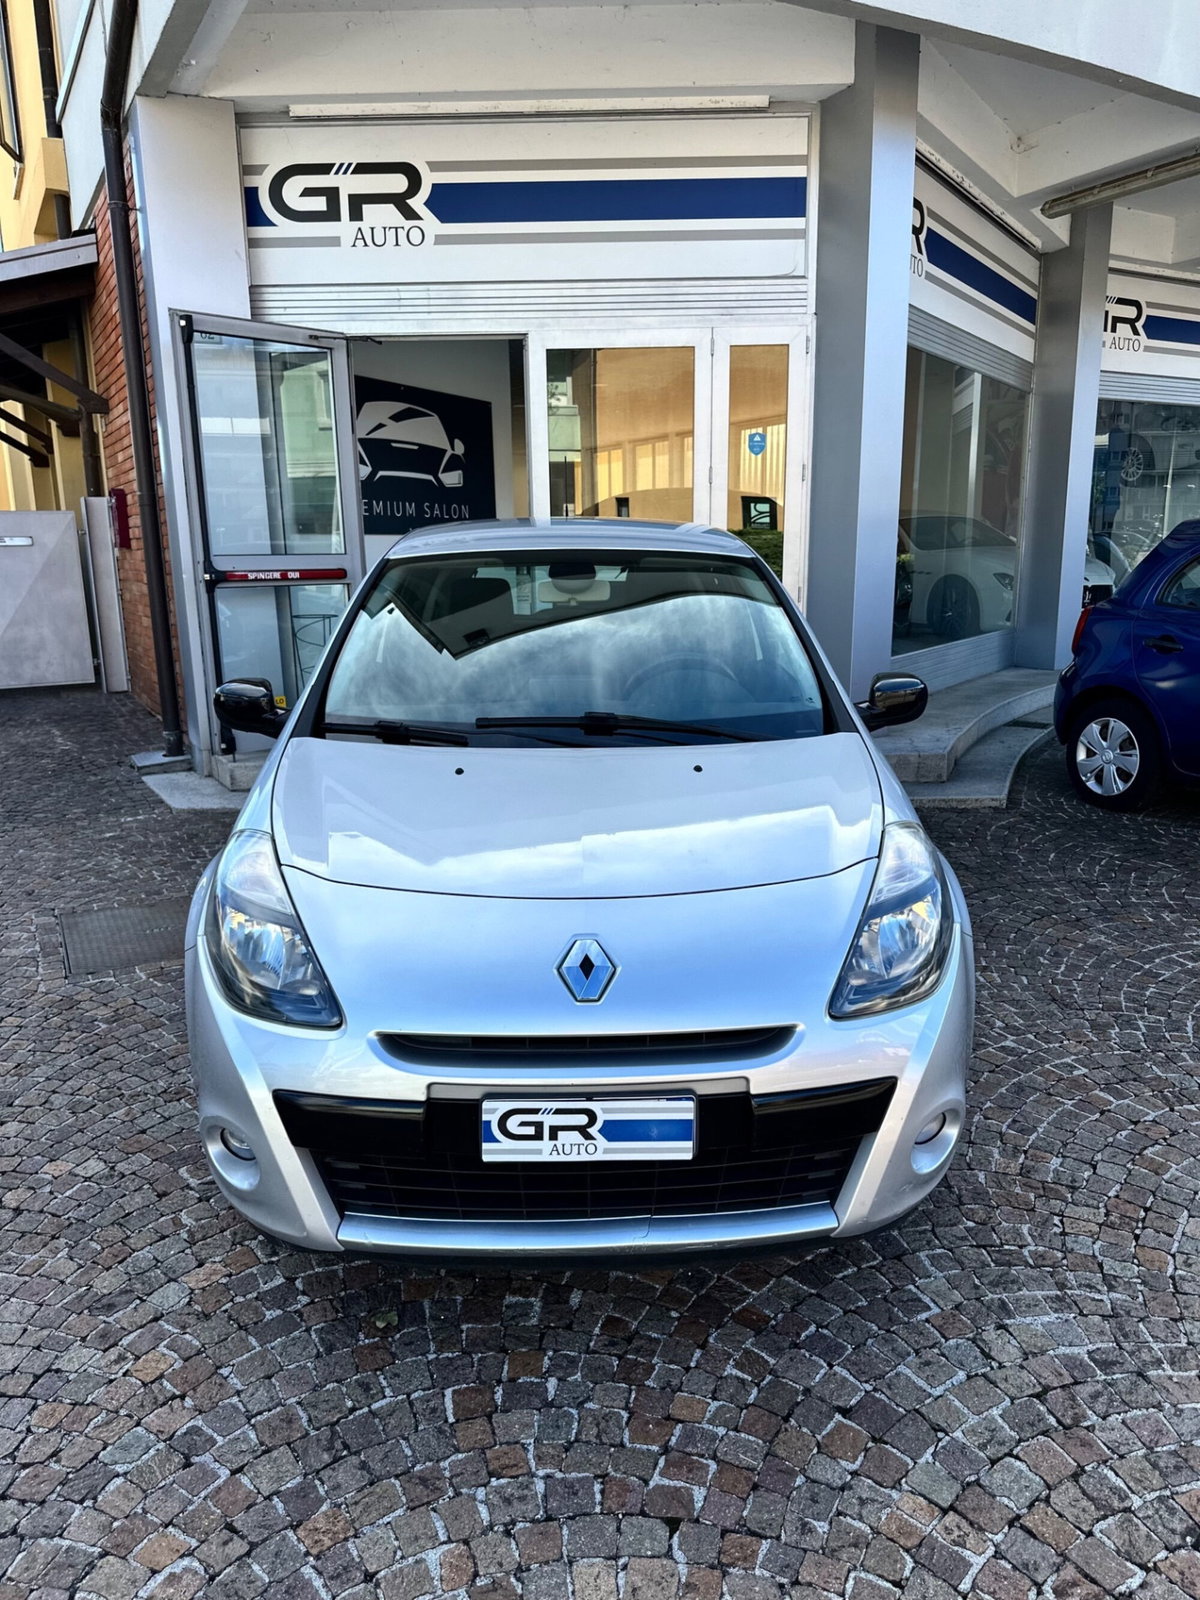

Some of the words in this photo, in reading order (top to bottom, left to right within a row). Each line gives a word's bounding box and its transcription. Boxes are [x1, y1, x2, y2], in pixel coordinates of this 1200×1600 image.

[268, 161, 425, 223] GR
[350, 225, 426, 248] AUTO
[1109, 336, 1141, 352] AUTO
[361, 499, 416, 517] EMIUM
[423, 502, 470, 519] SALON
[497, 1107, 598, 1141] GR
[549, 1142, 598, 1156] AUTO
